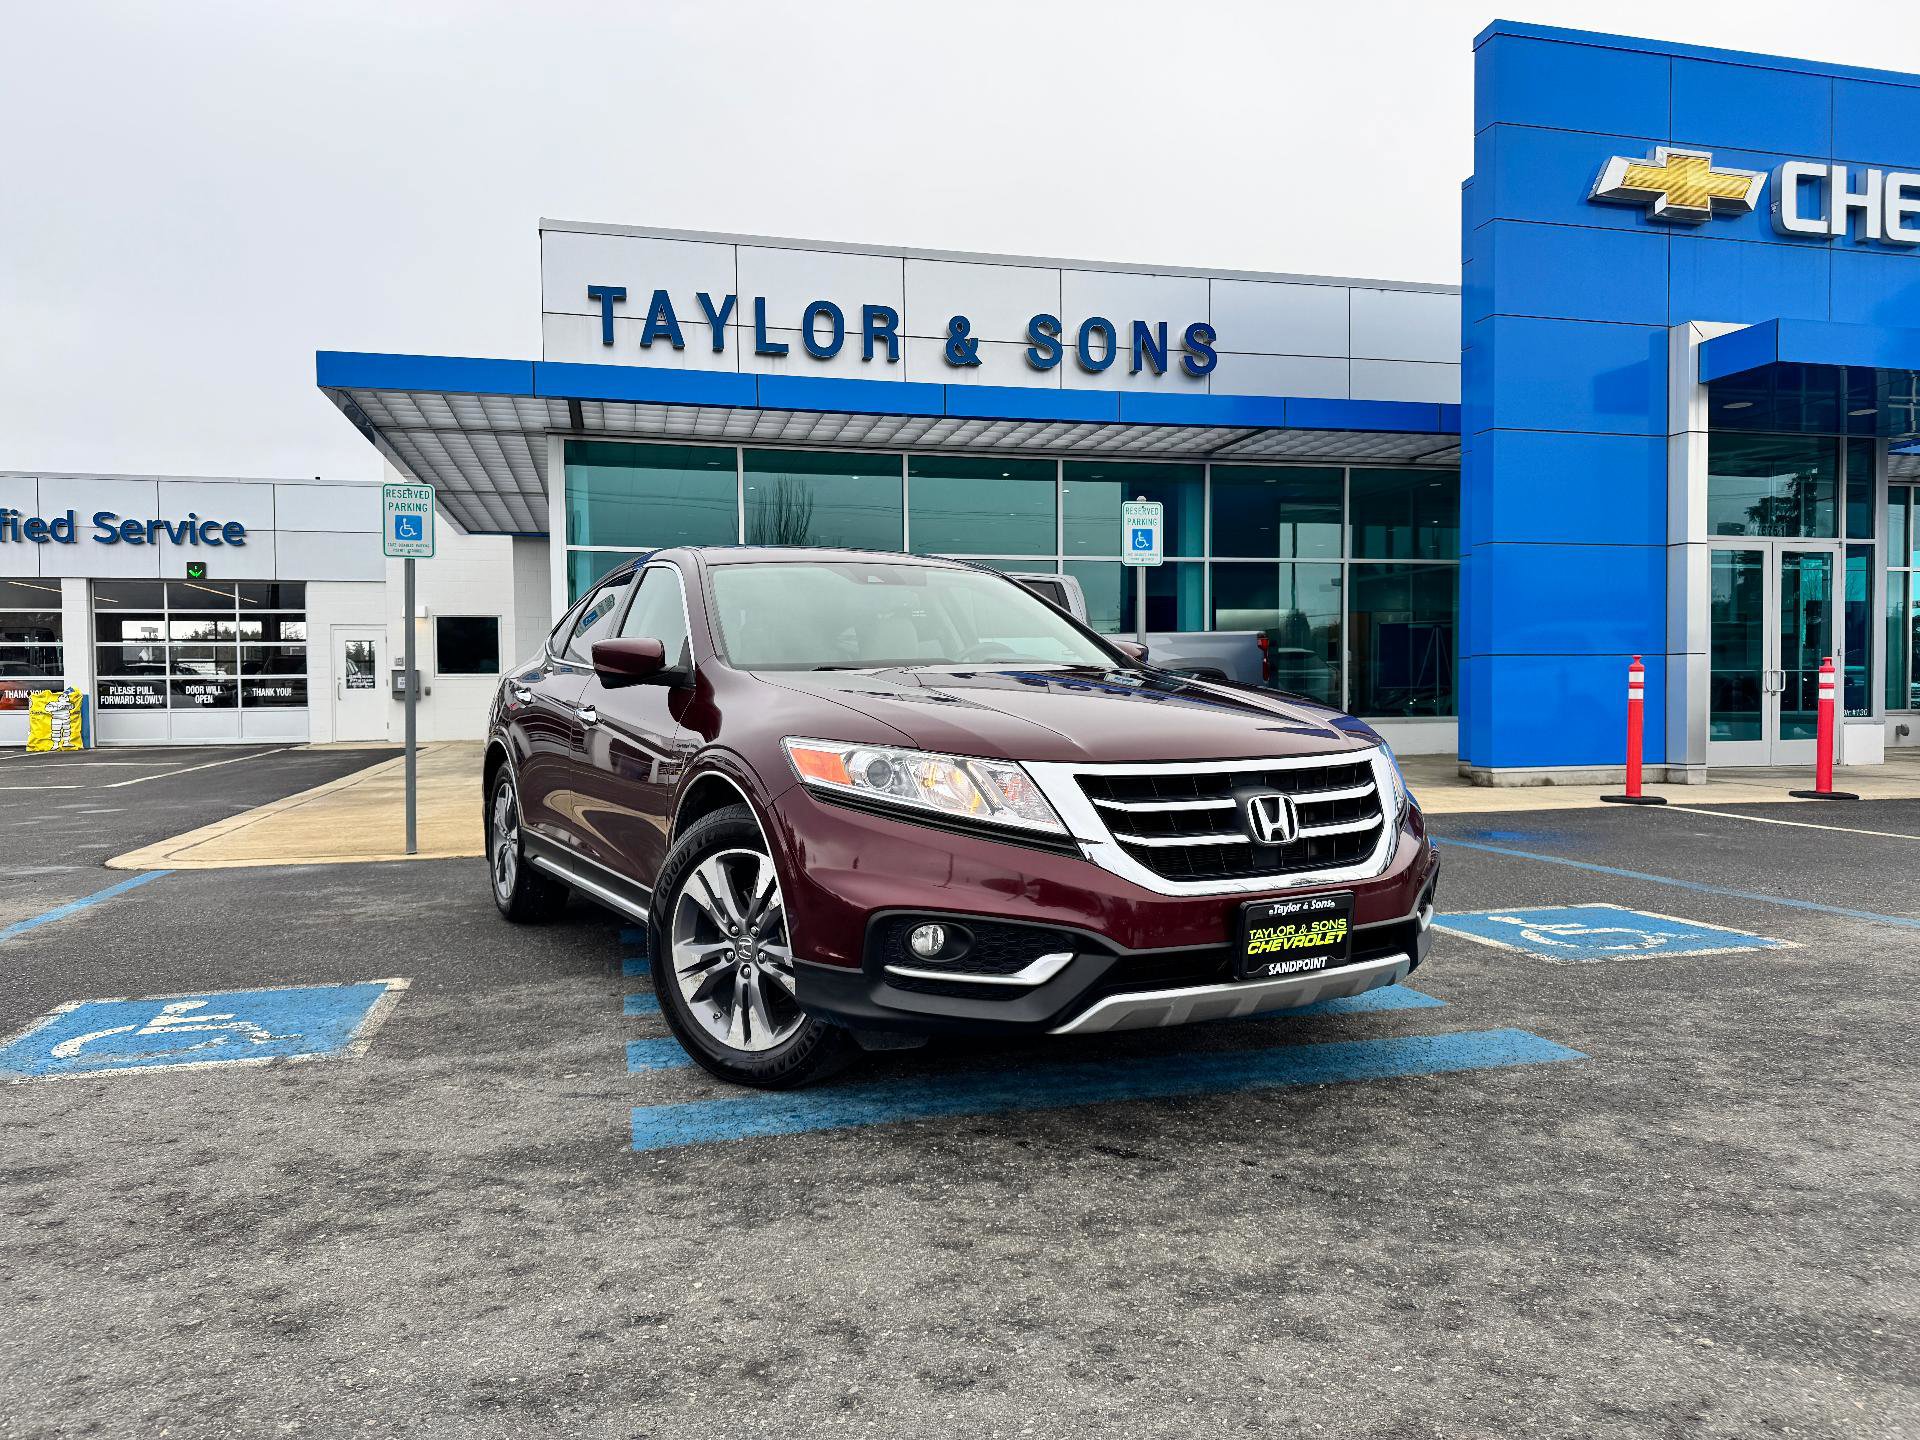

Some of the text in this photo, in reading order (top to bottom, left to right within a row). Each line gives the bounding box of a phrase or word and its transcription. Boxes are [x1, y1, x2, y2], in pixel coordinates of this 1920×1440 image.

[1770, 160, 1920, 244] CHE
[587, 284, 1219, 377] TAYLOR & SONS
[385, 488, 430, 499] RESERVED
[388, 501, 428, 512] PARKING
[1125, 506, 1159, 515] RESERVED
[1127, 518, 1158, 526] PARKING
[92, 511, 247, 546] Service
[4, 689, 29, 699] THANK
[109, 686, 155, 695] PLEASE PULL
[185, 685, 223, 694] DOOR WILL
[252, 687, 292, 697] THANK YOU!
[100, 695, 164, 705] FORWARD SLOWLY
[194, 695, 213, 704] OPEN
[1273, 899, 1332, 916] Taylor & Sons
[1249, 918, 1347, 940] TAYLOR & SONS
[1247, 930, 1347, 954] CHEVROLET
[1268, 956, 1328, 975] SANDPOINT
